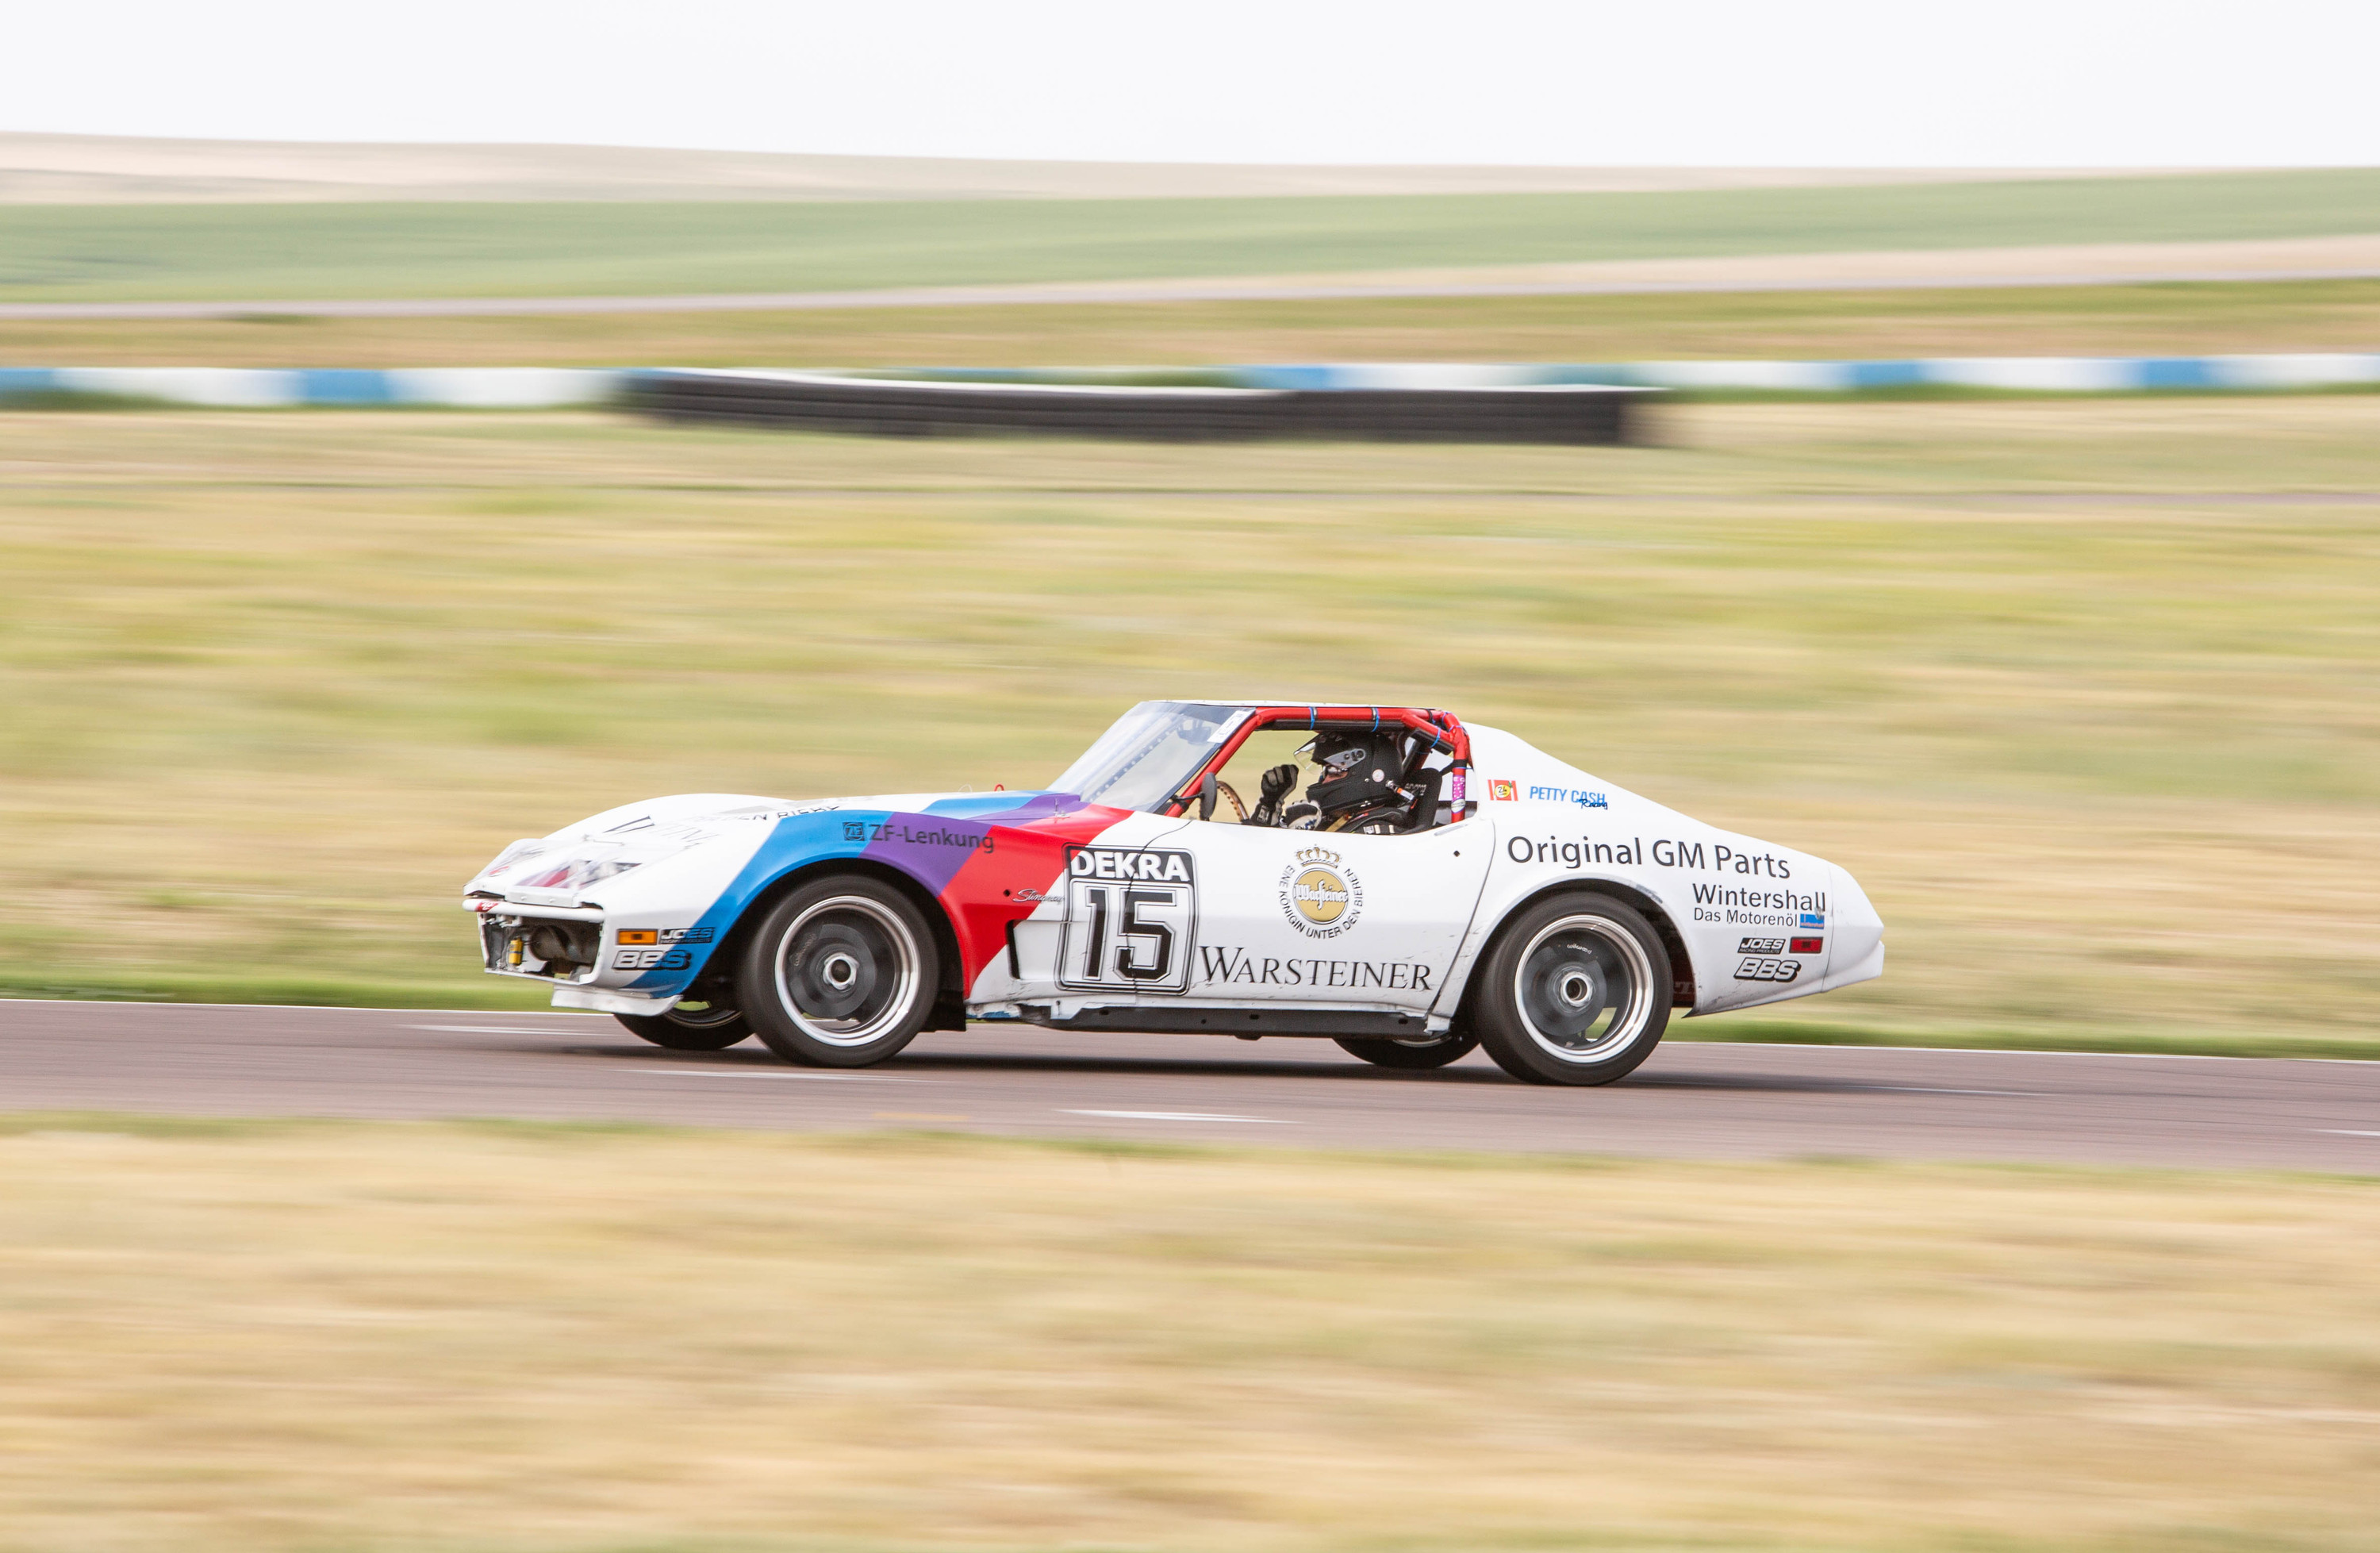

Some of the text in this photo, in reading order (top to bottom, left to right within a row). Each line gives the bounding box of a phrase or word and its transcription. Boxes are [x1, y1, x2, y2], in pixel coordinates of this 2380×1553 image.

[1530, 786, 1606, 805] PETTY CASH
[869, 824, 995, 854] ZF-Lenkung
[1071, 851, 1191, 882] DEKRA
[1507, 836, 1791, 879] Original GM Parts
[1279, 865, 1364, 940] EINE KÖNIGIN UNTER DEN BIEREN
[1692, 883, 1825, 912] Wintershall
[1694, 908, 1798, 928] Das Motorenöl
[660, 928, 713, 940] JOES
[1082, 886, 1177, 982] 15
[1741, 938, 1785, 950] JOES
[612, 950, 692, 971] BBS
[1198, 946, 1433, 991] WARSTEINER
[1733, 957, 1802, 982] BBS
